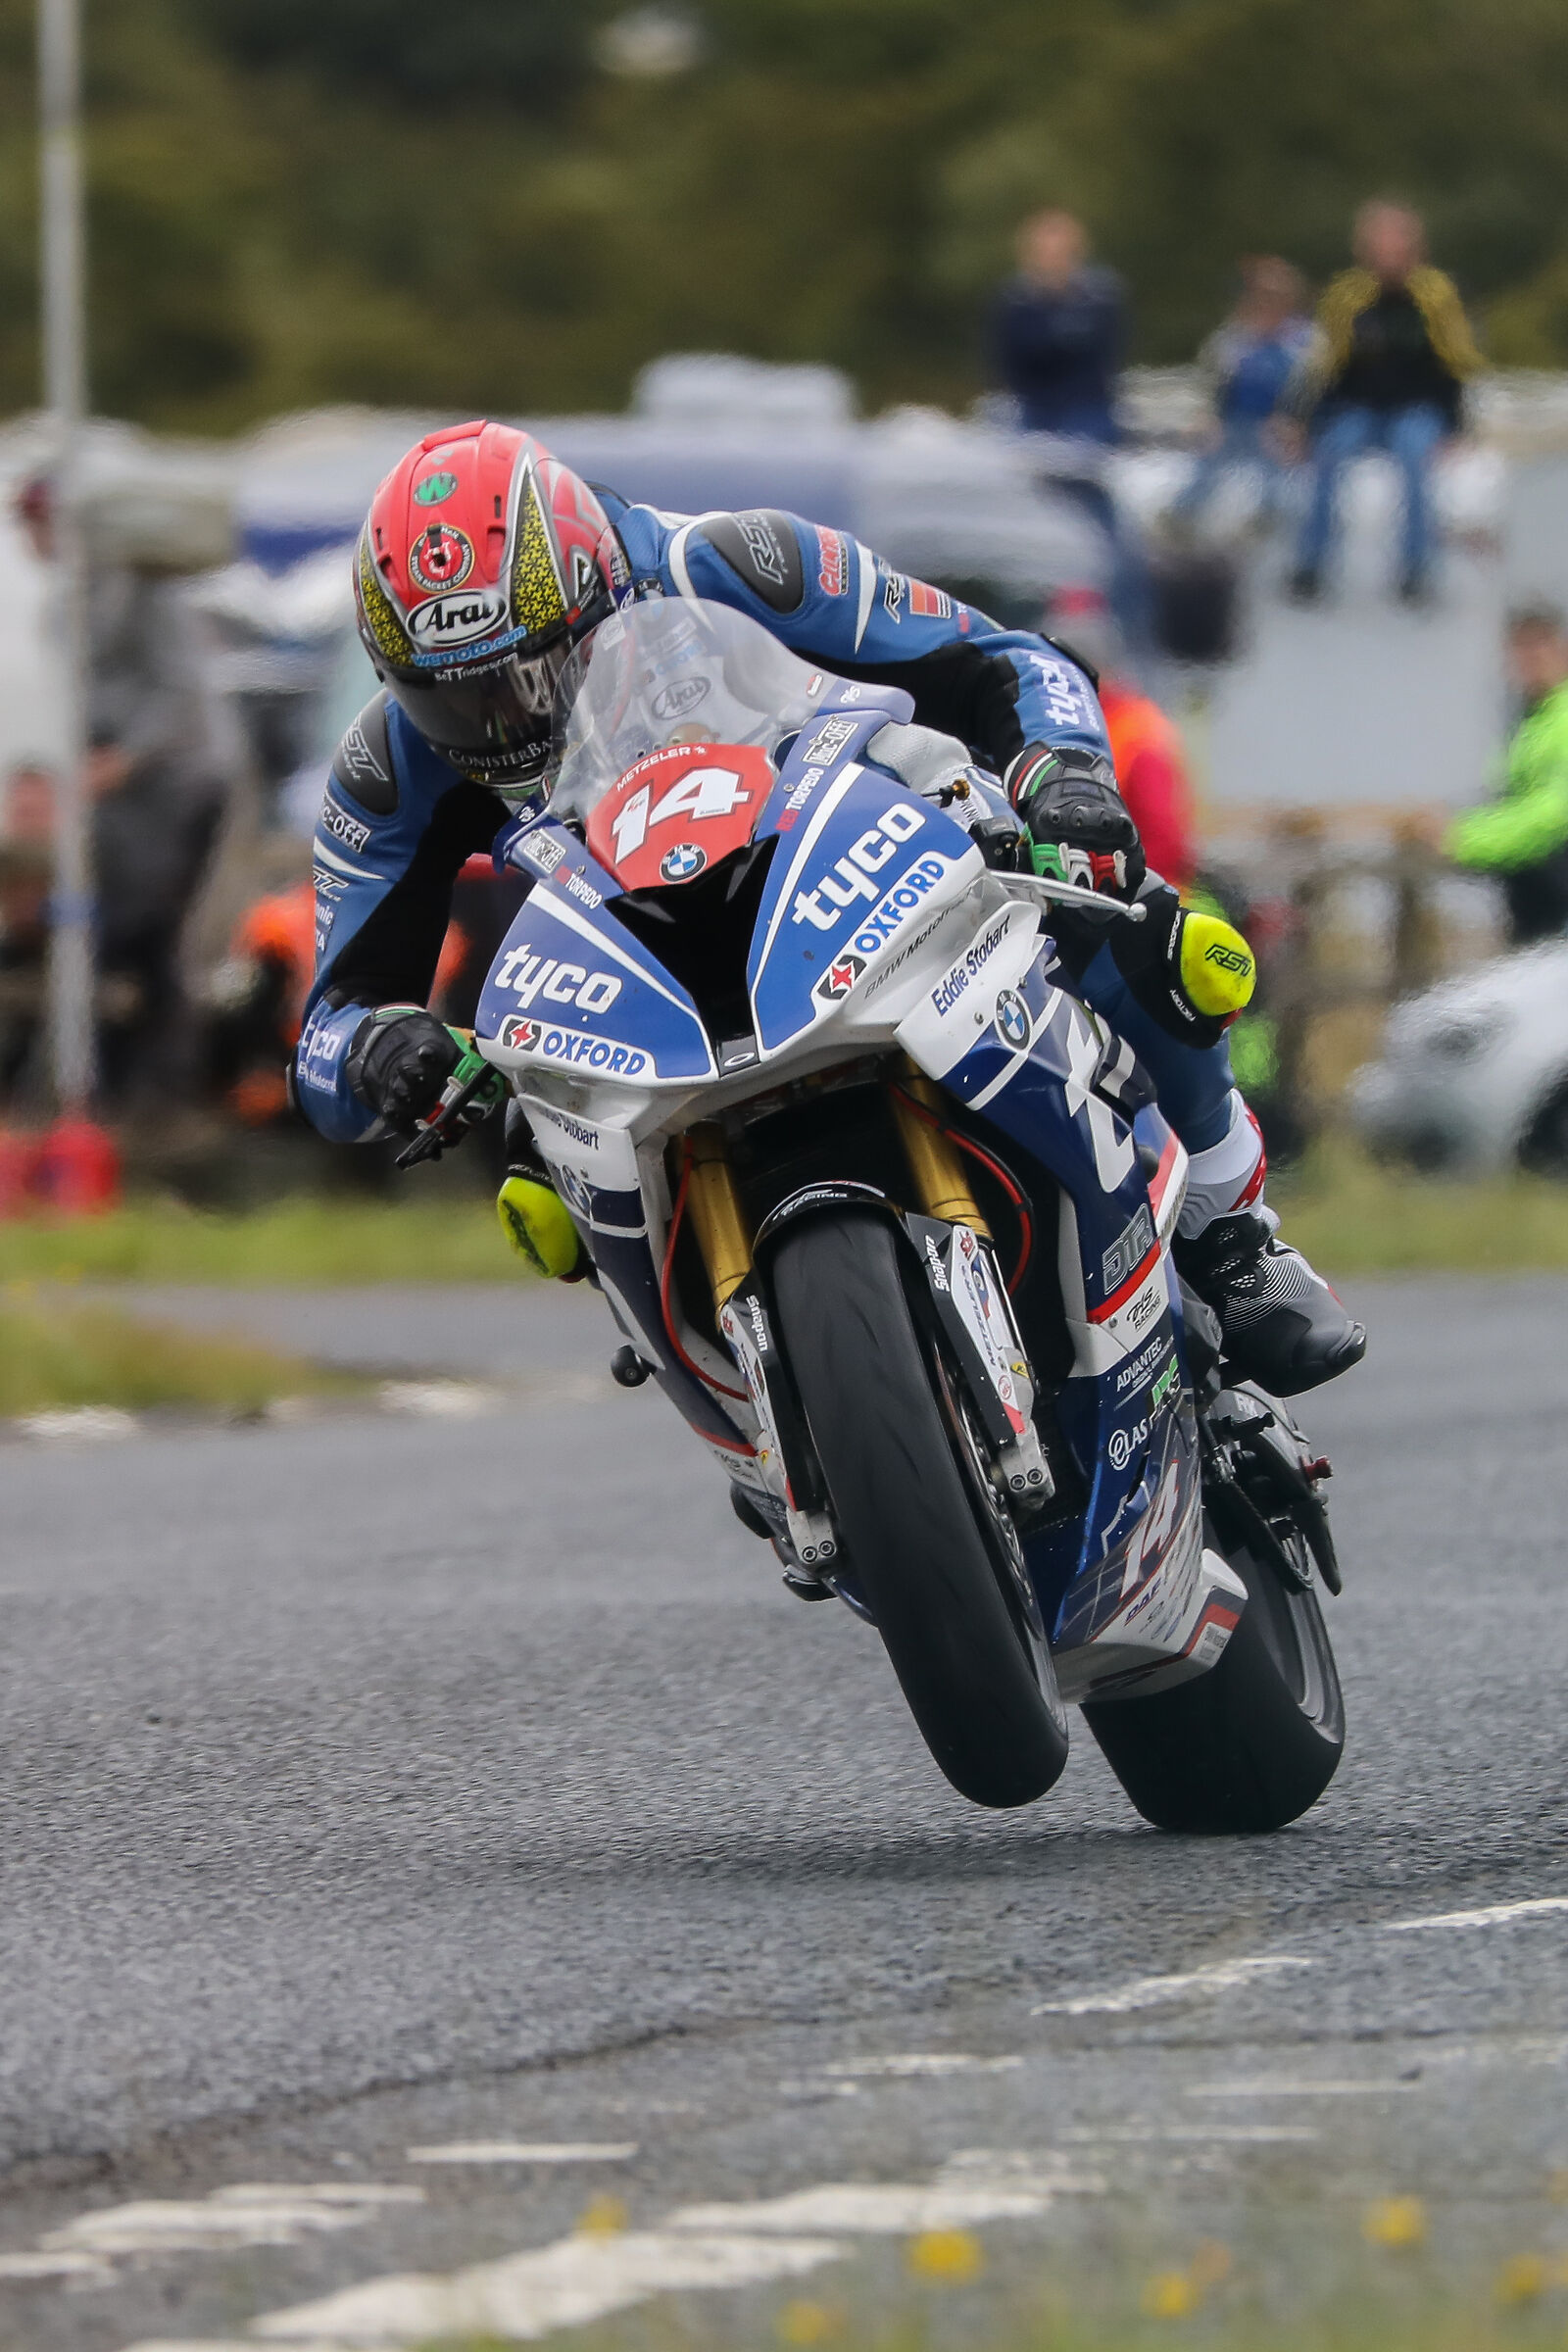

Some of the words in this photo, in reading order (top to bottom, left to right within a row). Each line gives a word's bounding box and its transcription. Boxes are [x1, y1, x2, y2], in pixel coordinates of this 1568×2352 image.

[416, 602, 494, 635] Arai
[411, 625, 527, 666] wemoto.com
[616, 746, 692, 792] METZELER
[785, 767, 825, 810] TORPEDO
[612, 766, 750, 865] 14
[792, 803, 926, 931] tyco
[565, 873, 603, 910] TORPEDO
[855, 860, 944, 953] OXFORD
[495, 943, 622, 1015] tyco
[931, 966, 970, 1016] Eddie
[965, 913, 1011, 976] Stobart
[1204, 944, 1252, 977] RST
[544, 1031, 646, 1076] OXFORD
[1134, 1295, 1162, 1331] RACING
[1116, 1336, 1163, 1392] ADVANTEC
